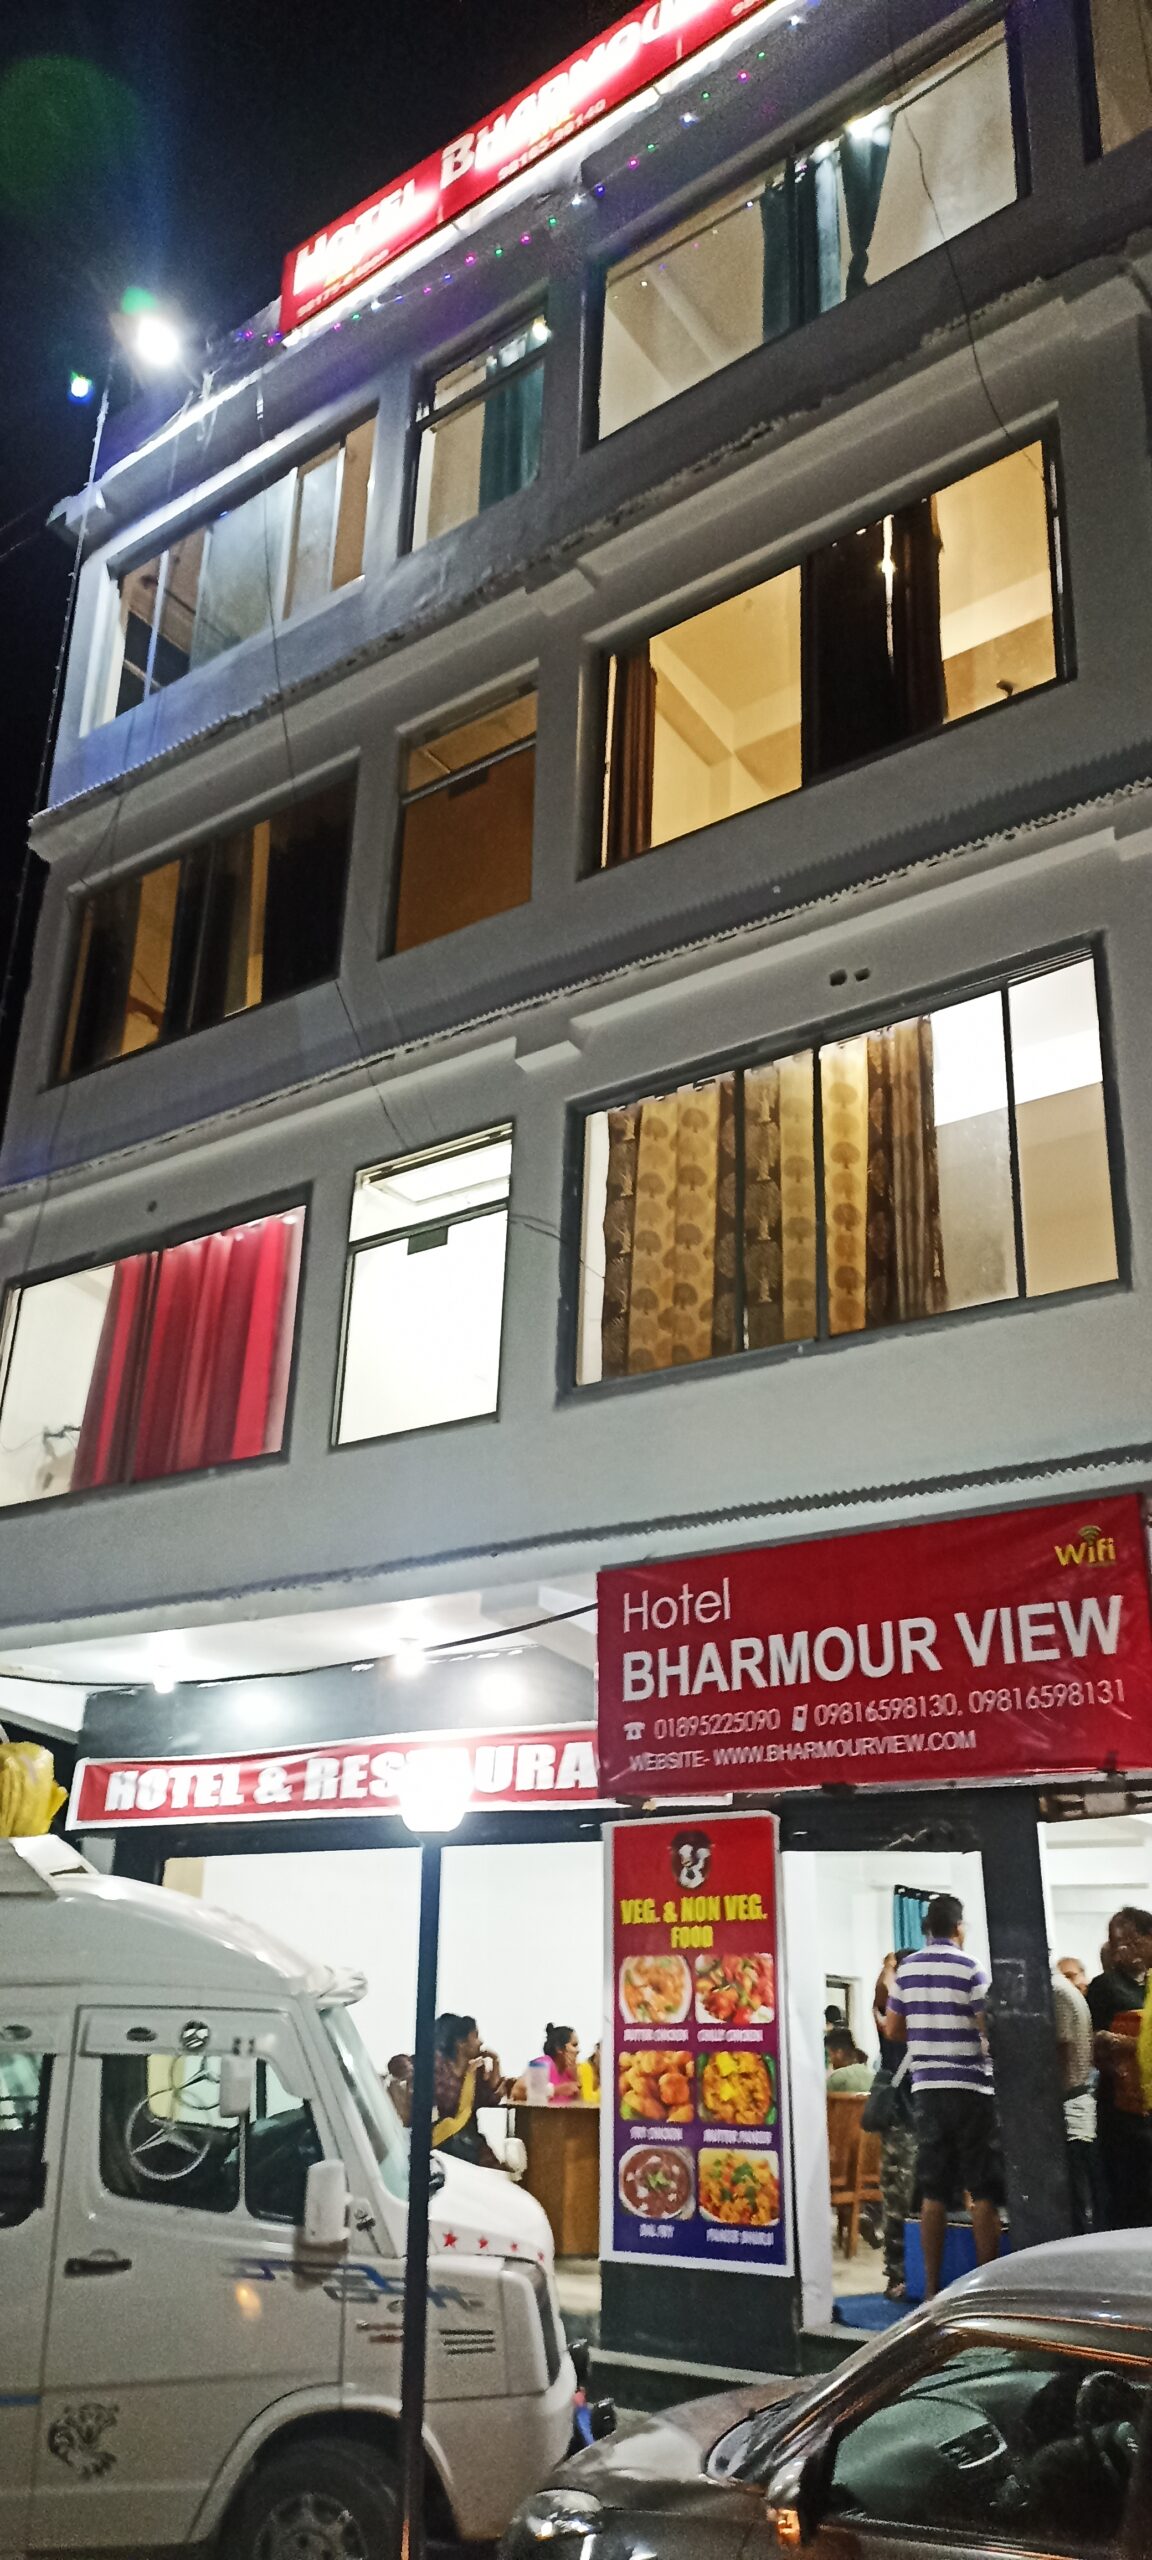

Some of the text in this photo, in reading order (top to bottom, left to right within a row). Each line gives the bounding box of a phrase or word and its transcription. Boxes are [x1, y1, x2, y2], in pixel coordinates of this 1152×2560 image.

[1054, 1537, 1116, 1566] Wifi
[622, 1577, 731, 1633] Hotel
[622, 1594, 1123, 1701] BHARMOUR VIEW
[653, 1708, 781, 1740] 01895225090
[968, 1678, 1126, 1714] 09816598131
[712, 1729, 978, 1767] WWW.BHARMOURVIEW.COM
[104, 1765, 244, 1812] HOTEL
[253, 1766, 292, 1805] &
[620, 1893, 768, 1925] VEG. & NON VEG.
[670, 1924, 714, 1949] FOOD
